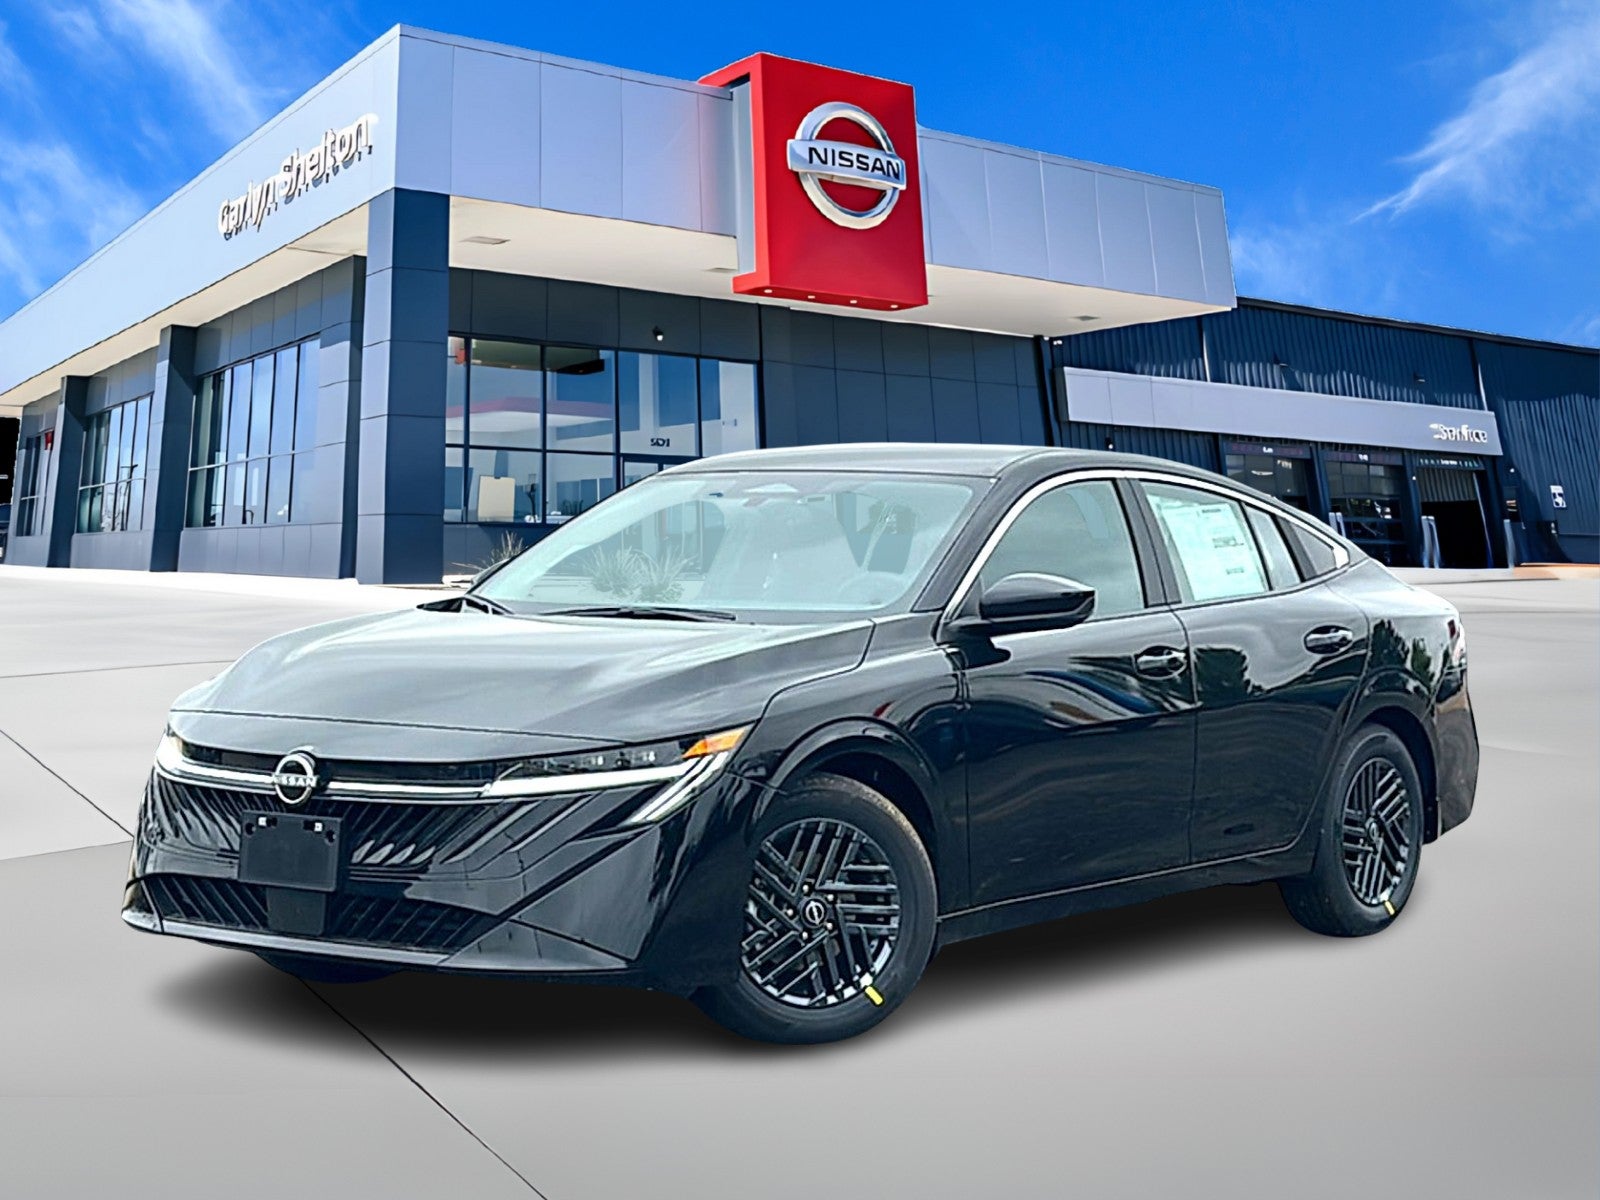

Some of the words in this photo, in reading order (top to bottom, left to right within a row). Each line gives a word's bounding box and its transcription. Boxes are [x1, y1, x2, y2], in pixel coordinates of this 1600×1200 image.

[279, 115, 373, 203] Shelton
[808, 146, 901, 181] NISSAN
[274, 775, 318, 788] SSAN
